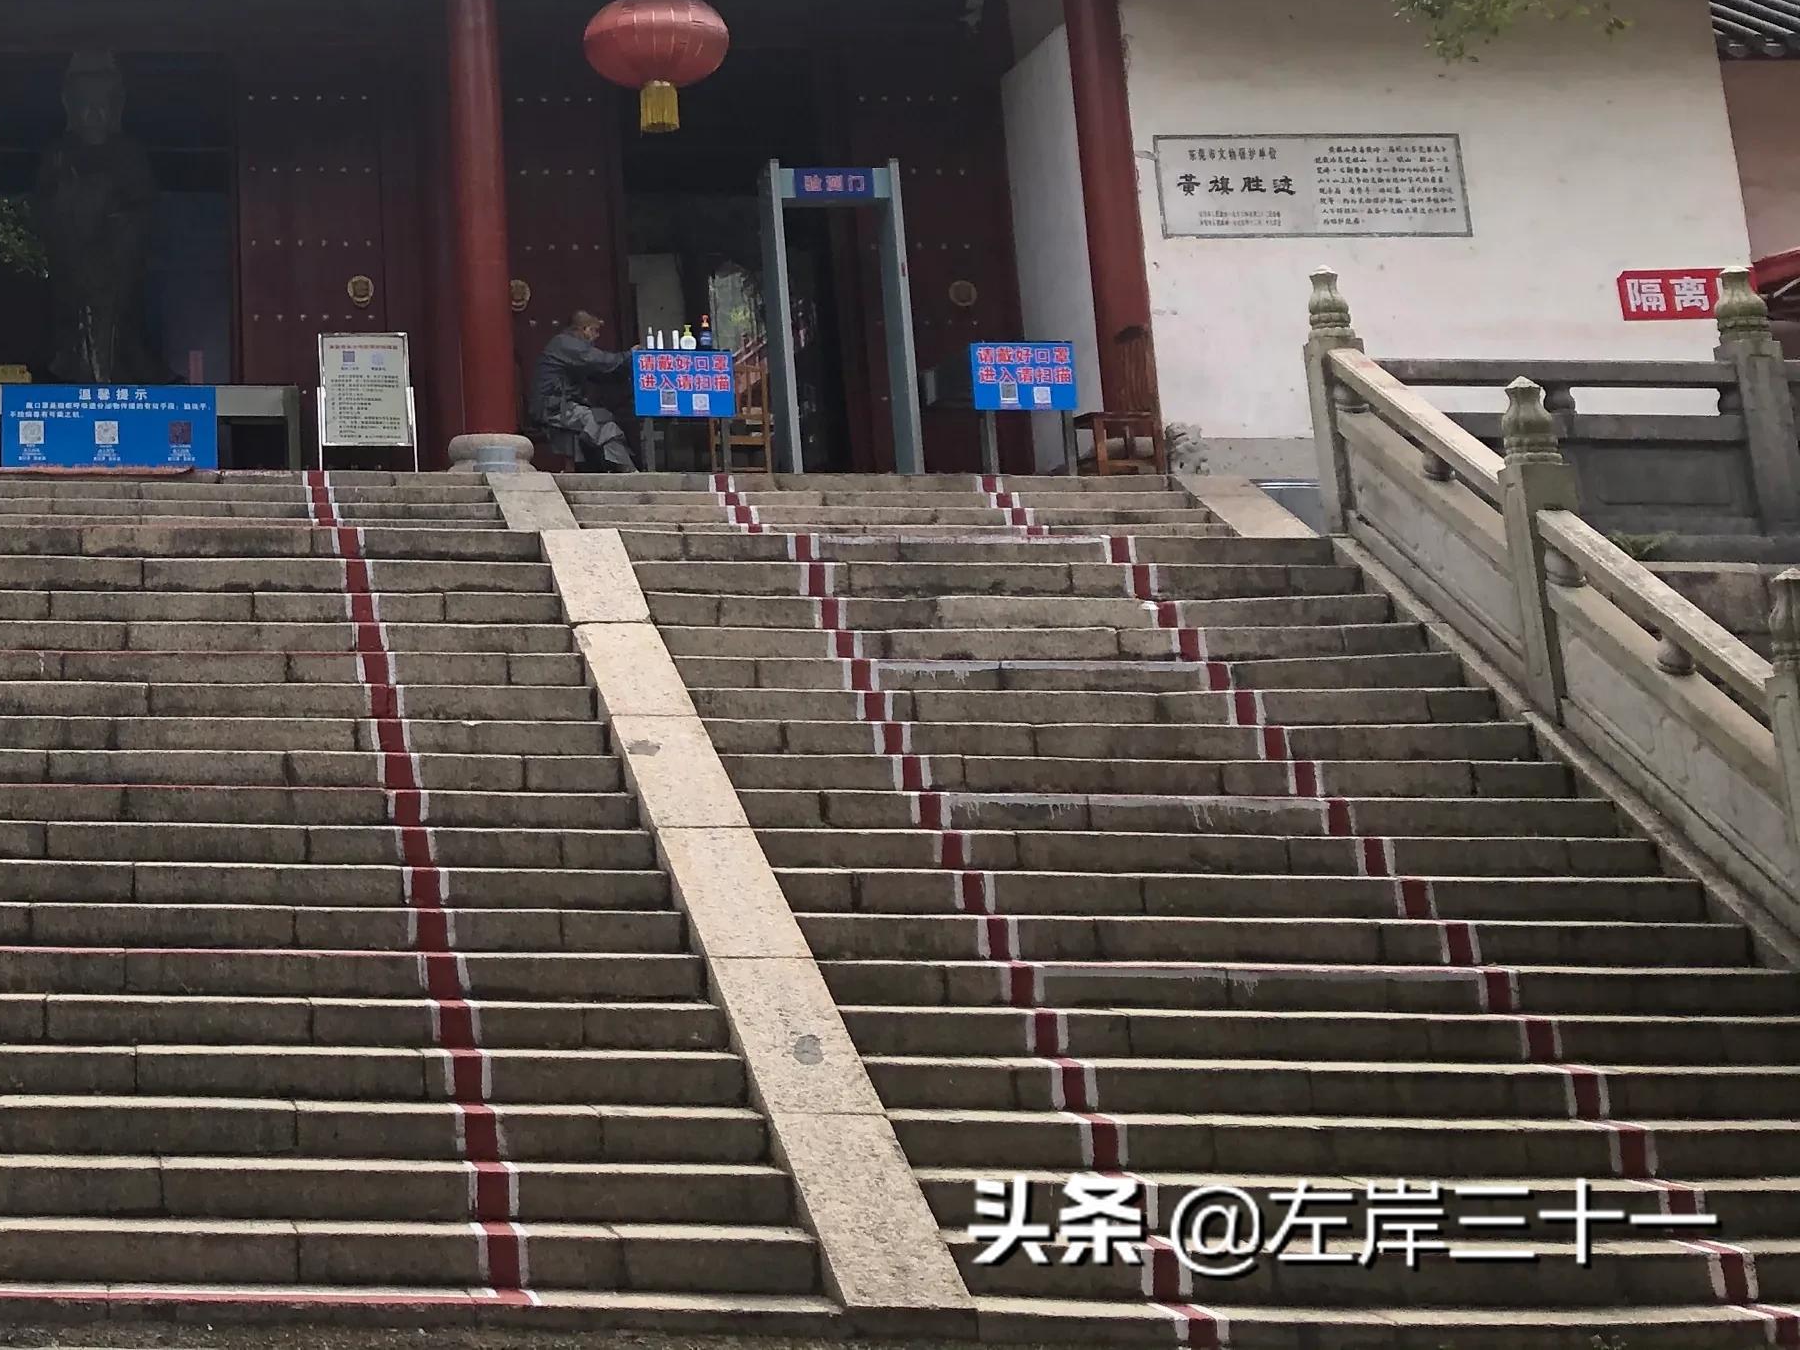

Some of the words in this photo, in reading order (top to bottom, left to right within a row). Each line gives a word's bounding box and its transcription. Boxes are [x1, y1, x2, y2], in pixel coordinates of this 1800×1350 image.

[1625, 276, 1722, 312] 隔离
[638, 353, 730, 372] 请戴好口罩
[976, 346, 1071, 364] 请戴好口罩
[639, 373, 731, 392] 进入请扫描
[978, 366, 1073, 384] 进入请扫描
[78, 388, 148, 400] 温馨提示
